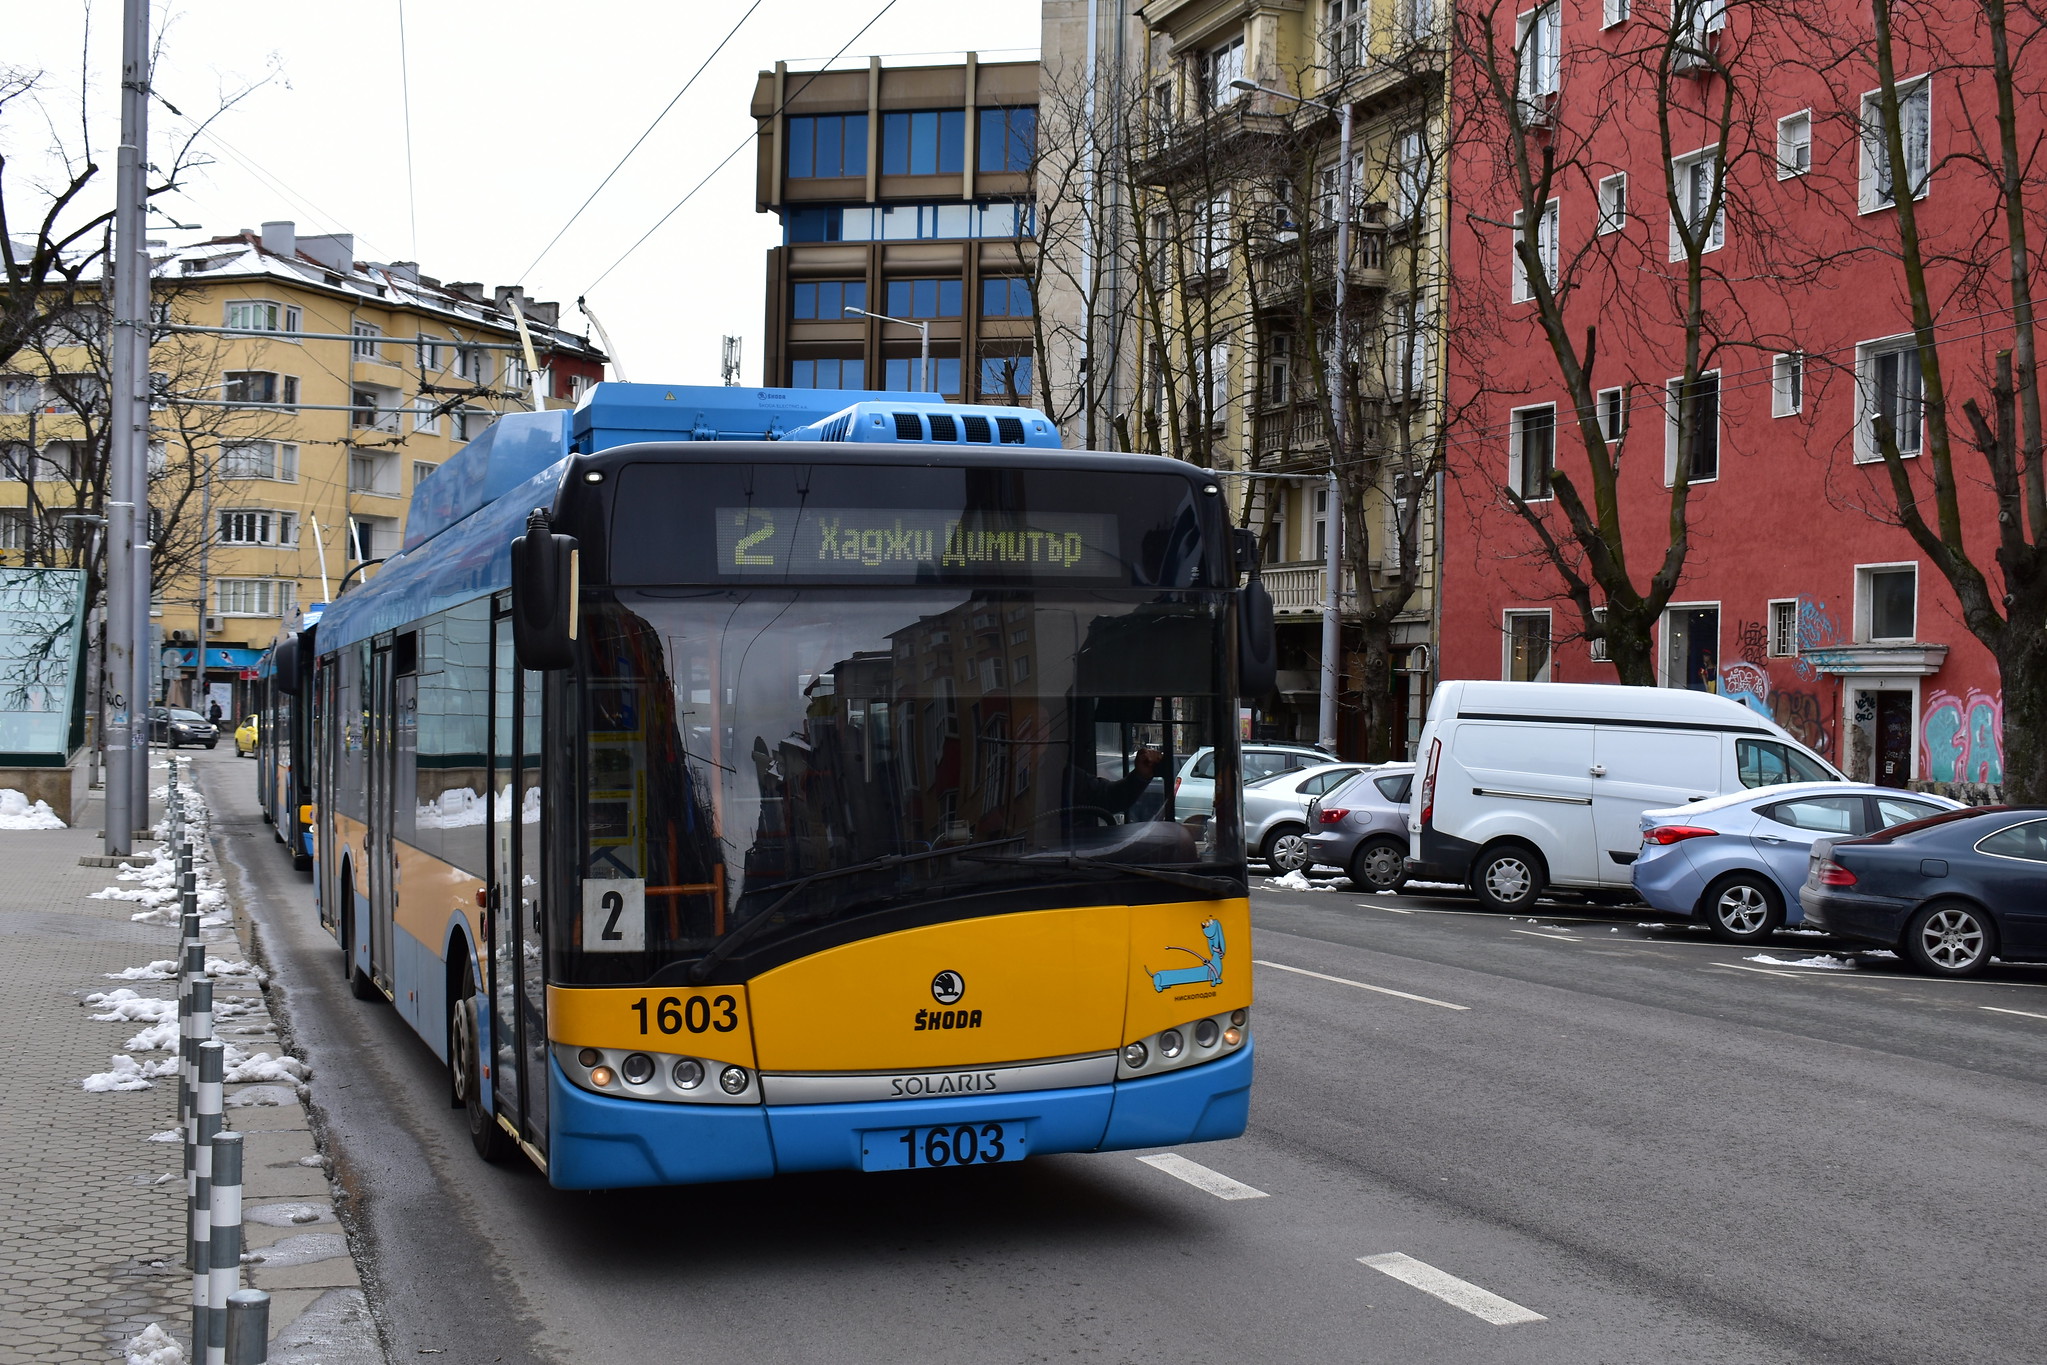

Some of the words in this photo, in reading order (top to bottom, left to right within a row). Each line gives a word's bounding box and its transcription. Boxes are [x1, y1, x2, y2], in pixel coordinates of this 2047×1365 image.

[735, 508, 775, 565] 2
[819, 519, 934, 566] Хаджи
[942, 520, 1082, 567] Димитър
[601, 890, 624, 940] 2
[631, 994, 738, 1035] 1603
[914, 1008, 983, 1031] ŠKODA
[891, 1073, 997, 1097] SOLARIS
[900, 1123, 1005, 1168] 1603
